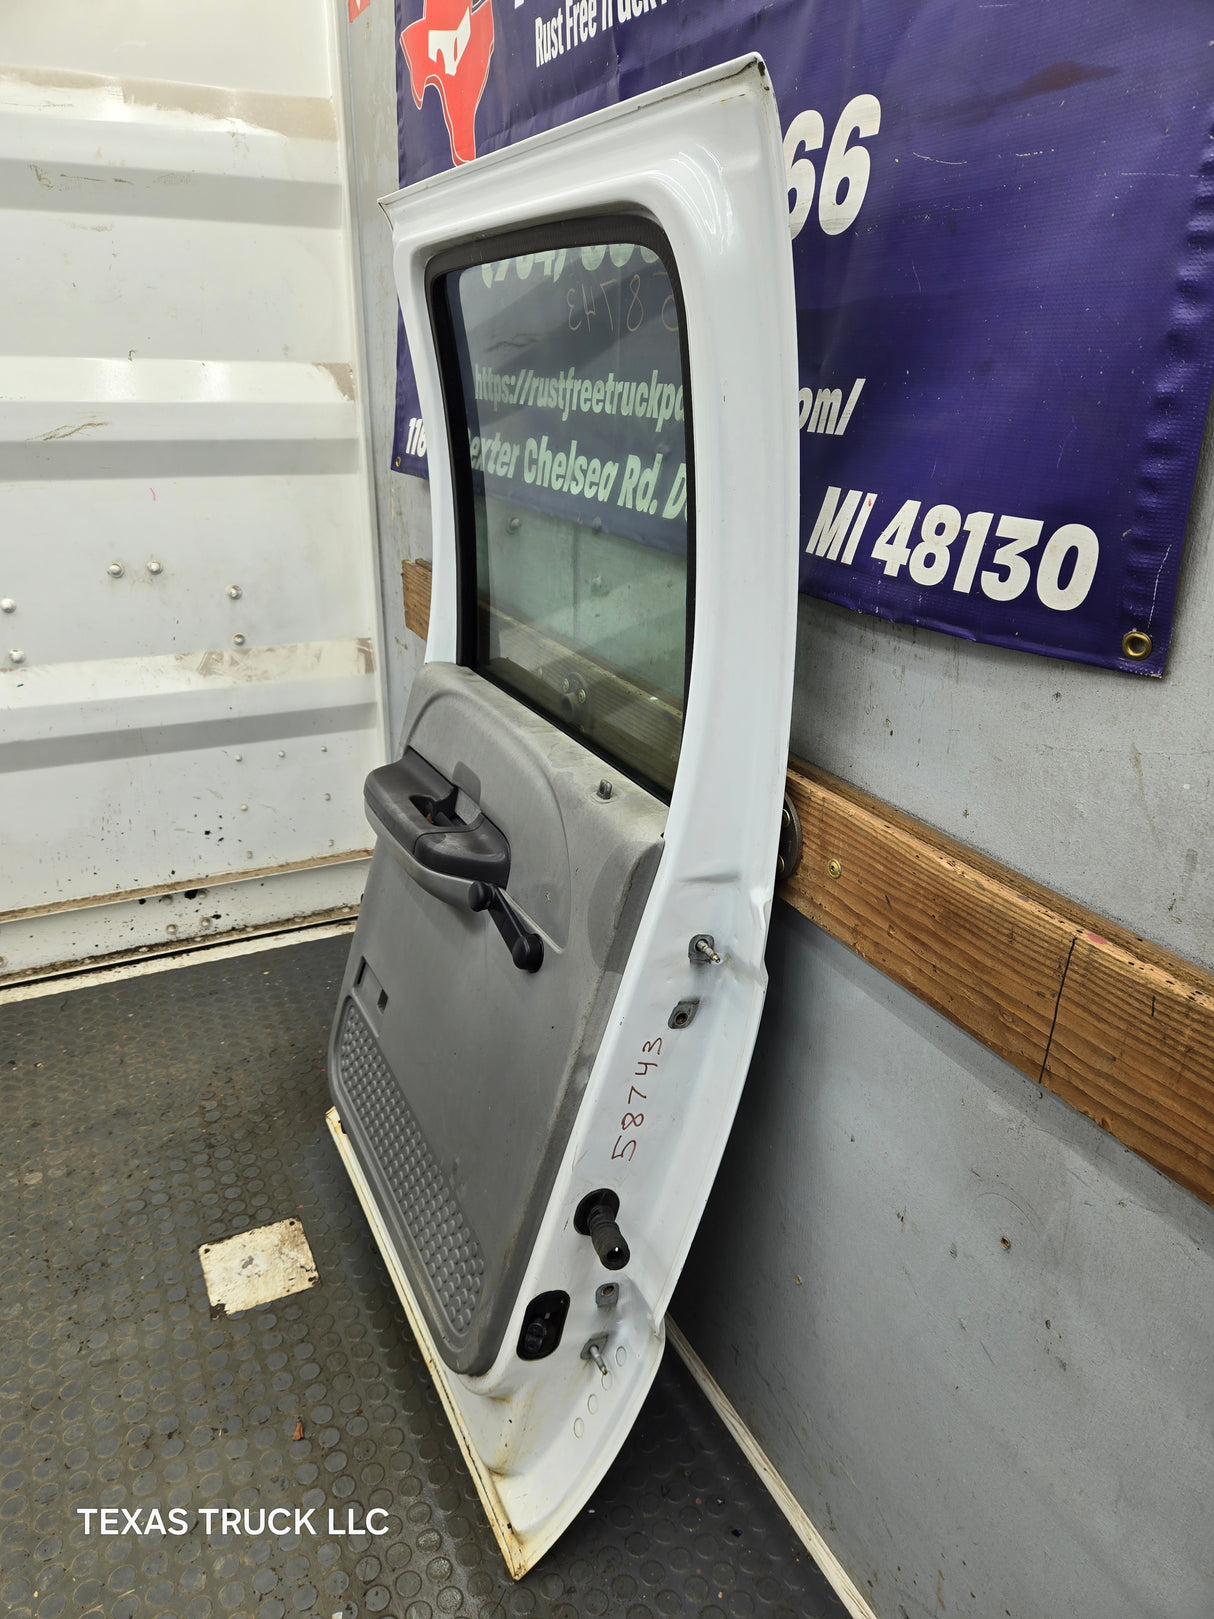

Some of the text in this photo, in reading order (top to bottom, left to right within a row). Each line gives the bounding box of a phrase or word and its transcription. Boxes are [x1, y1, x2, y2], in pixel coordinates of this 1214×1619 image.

[535, 8, 565, 68] Rust
[566, 0, 598, 51] Free
[468, 427, 520, 479] exter
[523, 435, 619, 502] Chelsea
[617, 453, 663, 515] Rd.
[805, 485, 878, 565] MI
[870, 499, 1100, 611] 48130
[611, 1037, 663, 1162] 58743
